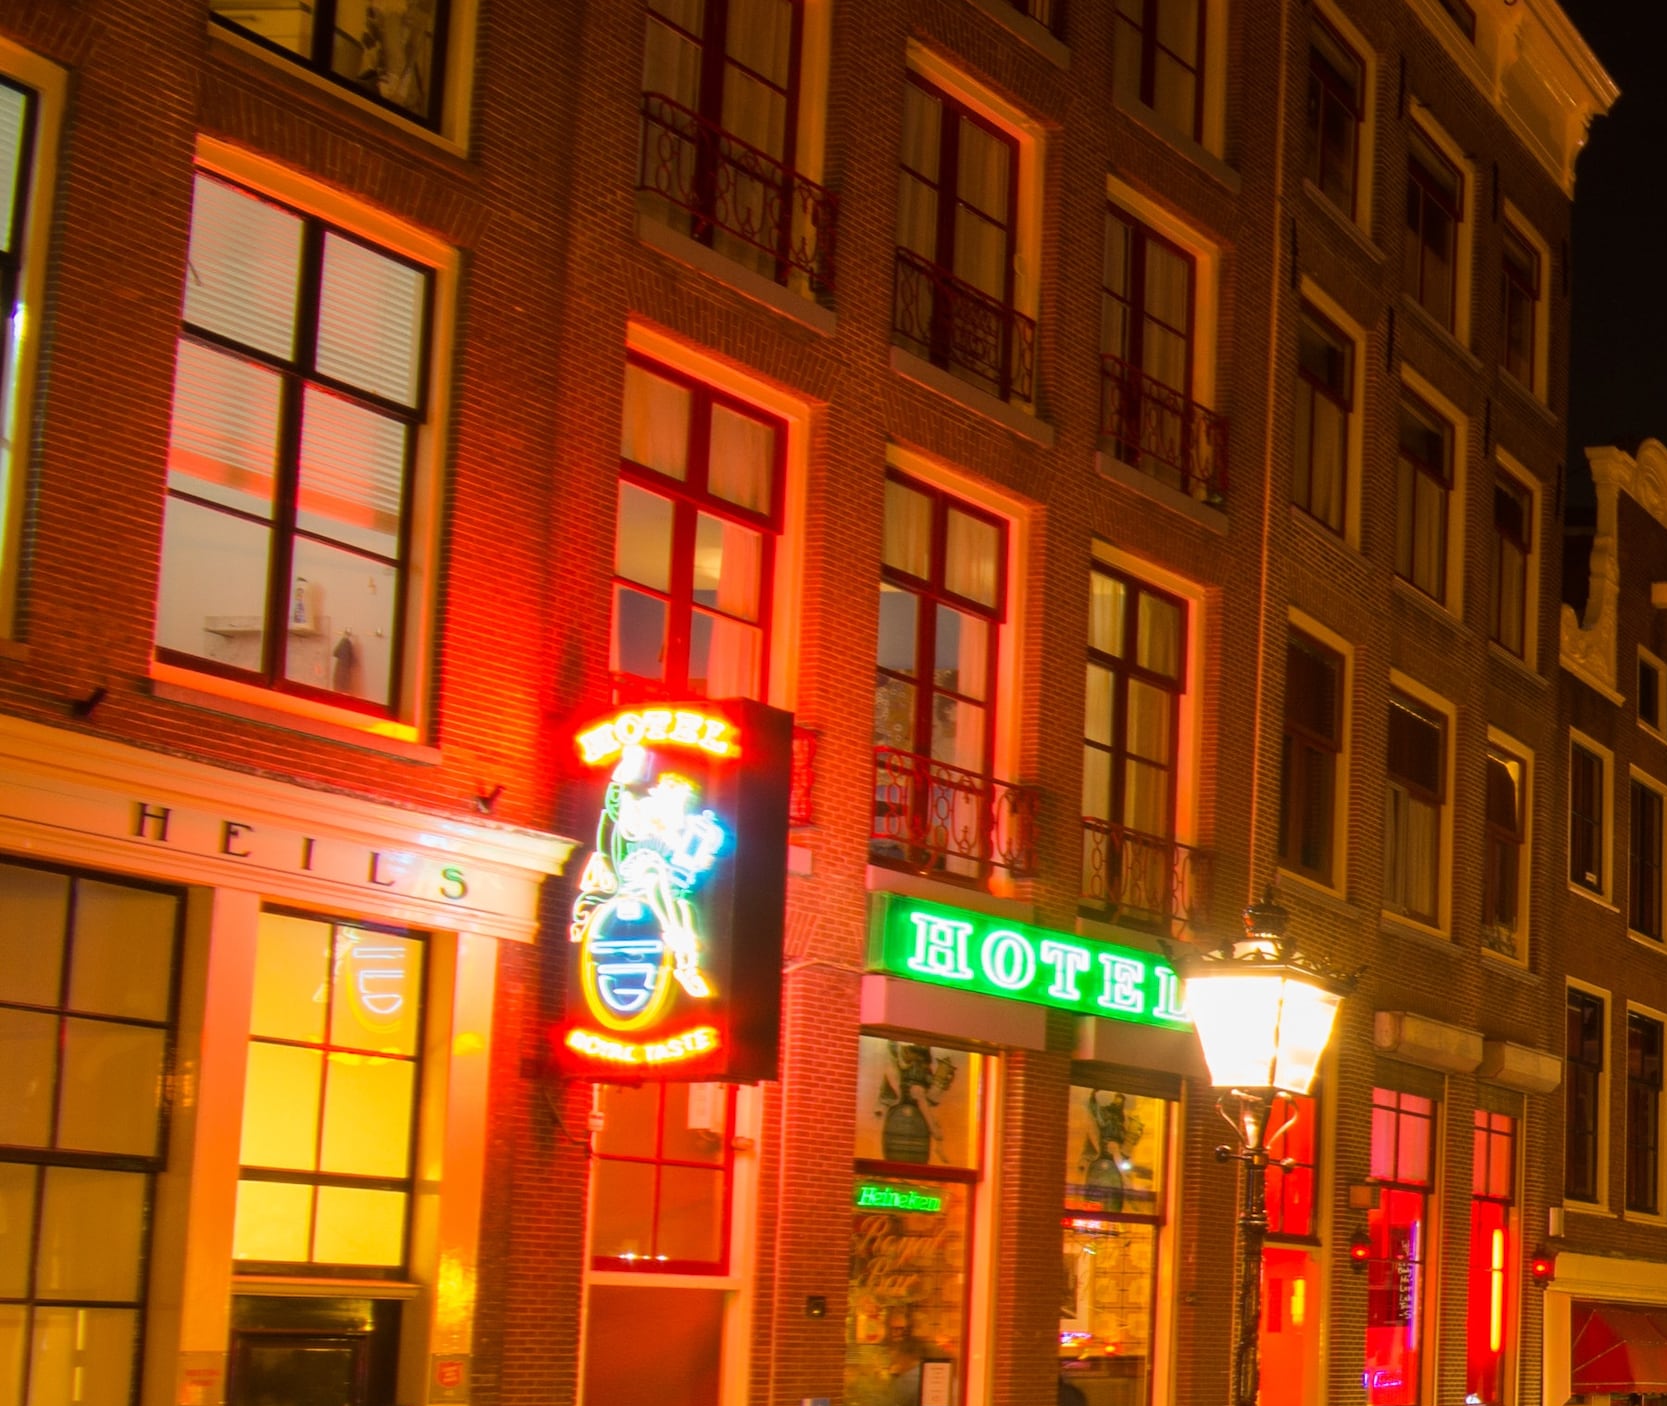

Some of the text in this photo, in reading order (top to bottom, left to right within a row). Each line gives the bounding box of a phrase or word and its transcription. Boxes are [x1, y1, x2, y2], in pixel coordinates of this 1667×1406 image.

[575, 708, 739, 766] HOTEL
[130, 801, 468, 900] HEILS
[907, 911, 1194, 1023] HOTEL
[857, 1186, 942, 1212] Heineken
[853, 1215, 947, 1266] Royal
[862, 1256, 919, 1297] Bar
